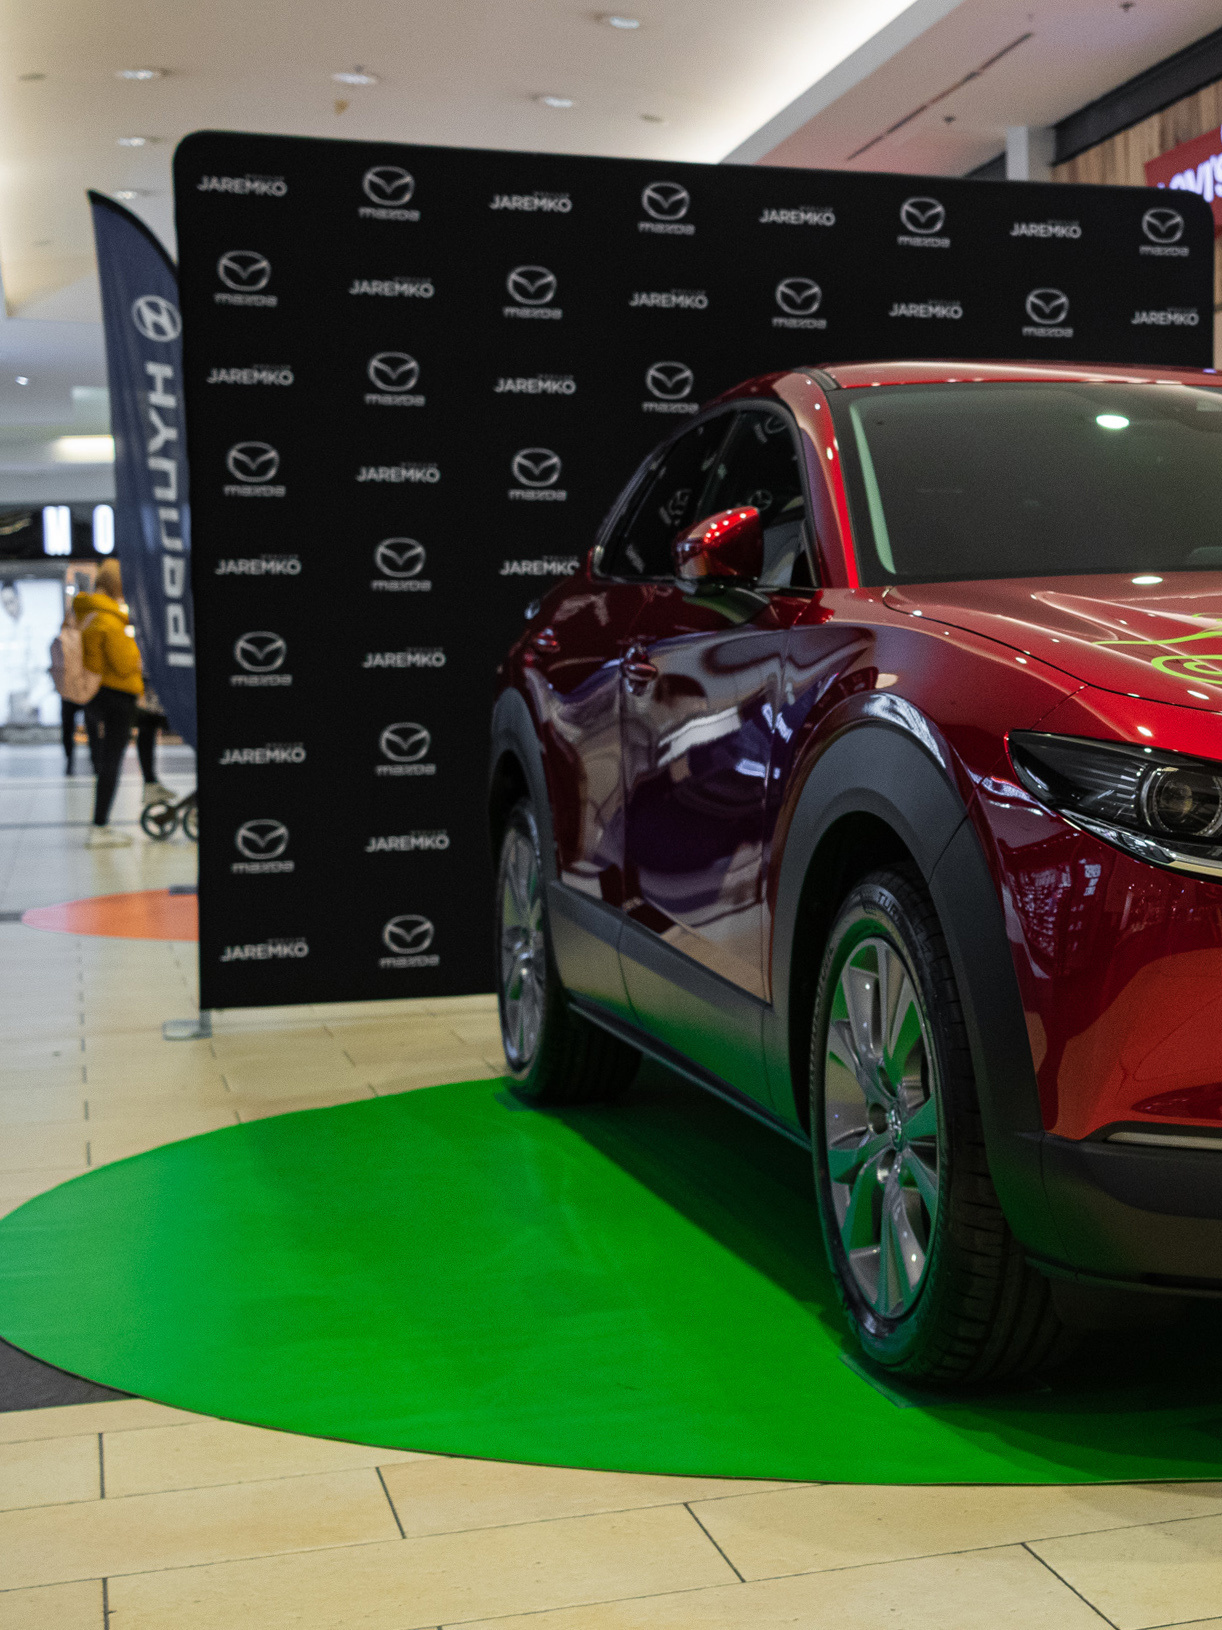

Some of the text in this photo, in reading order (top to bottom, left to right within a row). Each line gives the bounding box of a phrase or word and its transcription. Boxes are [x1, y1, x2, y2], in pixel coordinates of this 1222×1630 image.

[198, 176, 288, 197] JAREMKO
[490, 195, 573, 213] JAREMKO
[759, 209, 836, 227] JAREMKO
[1010, 222, 1082, 239] JAREMKO
[349, 280, 435, 298] JAREMKO
[629, 292, 709, 309] JAREMKO
[889, 303, 963, 320] JAREMKO
[1131, 310, 1200, 326] JAREMKO
[207, 368, 294, 386] JAREMKO
[494, 378, 577, 395] JAREMKO
[357, 466, 441, 483] JAREMKO
[145, 362, 196, 668] HYUNDAI
[216, 558, 302, 575] JAREMKO
[363, 651, 446, 668] JAREMKO
[220, 746, 306, 765] JAREMKO
[366, 833, 450, 853] JAREMKO
[221, 941, 309, 962] JAREMKO
